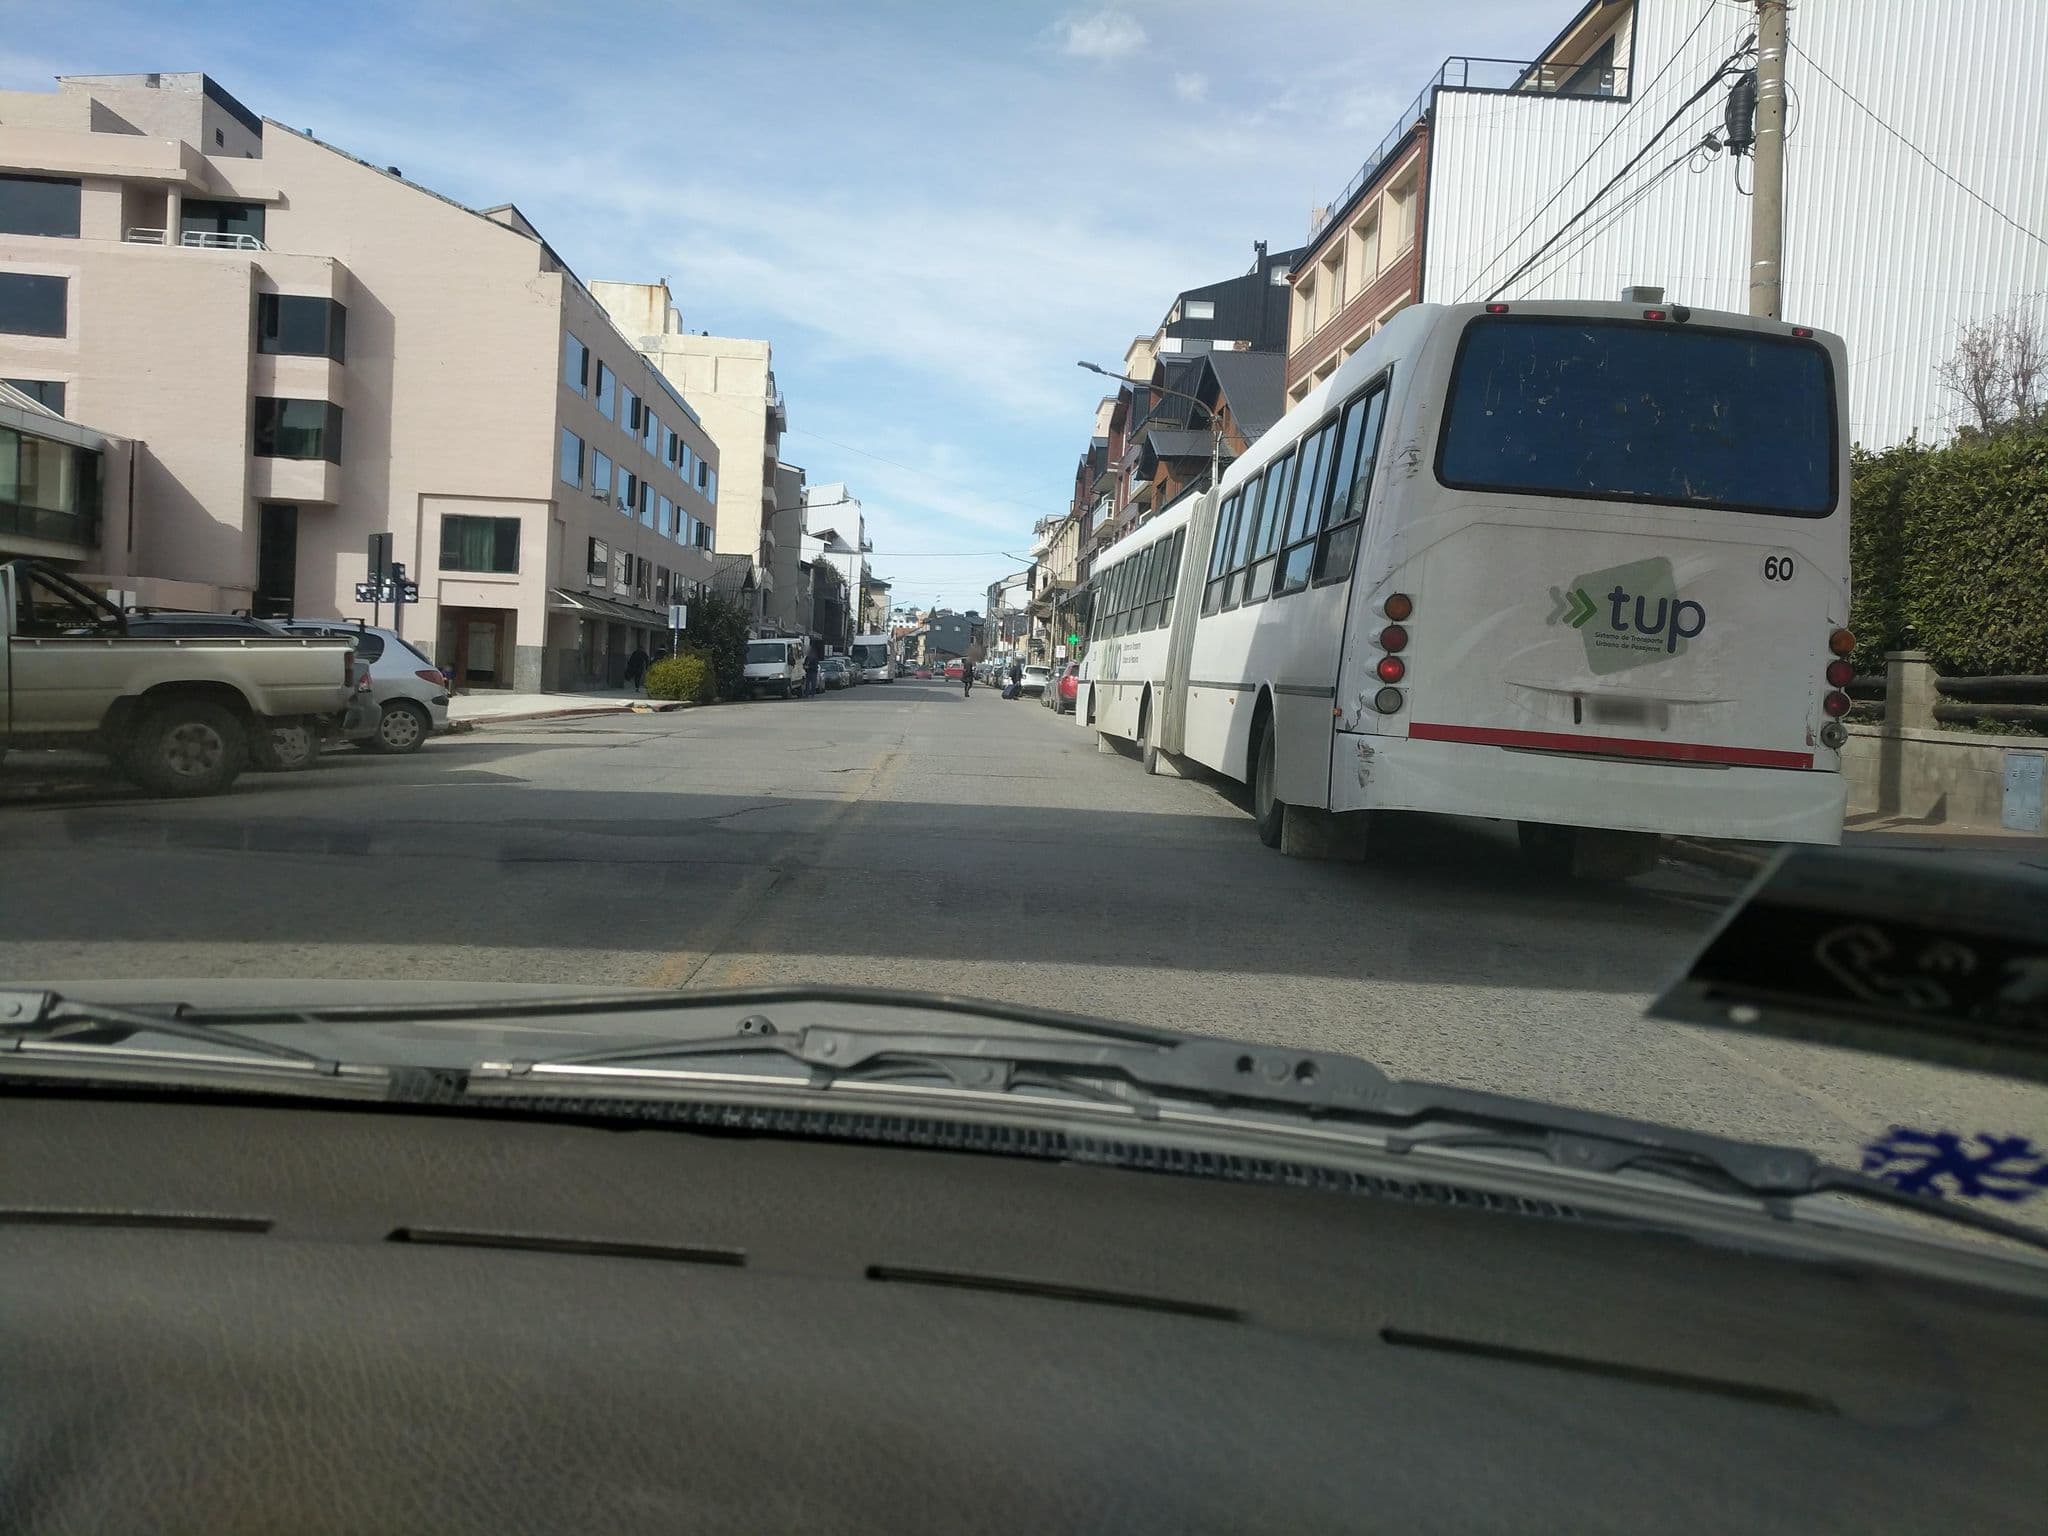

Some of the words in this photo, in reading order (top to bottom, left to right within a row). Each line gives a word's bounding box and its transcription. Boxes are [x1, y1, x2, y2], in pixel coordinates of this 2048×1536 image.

[1764, 556, 1794, 581] 60
[1608, 586, 1706, 653] tup
[1594, 631, 1619, 640] Sistema
[1631, 635, 1663, 644] Transporte
[1595, 640, 1619, 648] Urbano
[1631, 643, 1661, 652] Pasajeros
